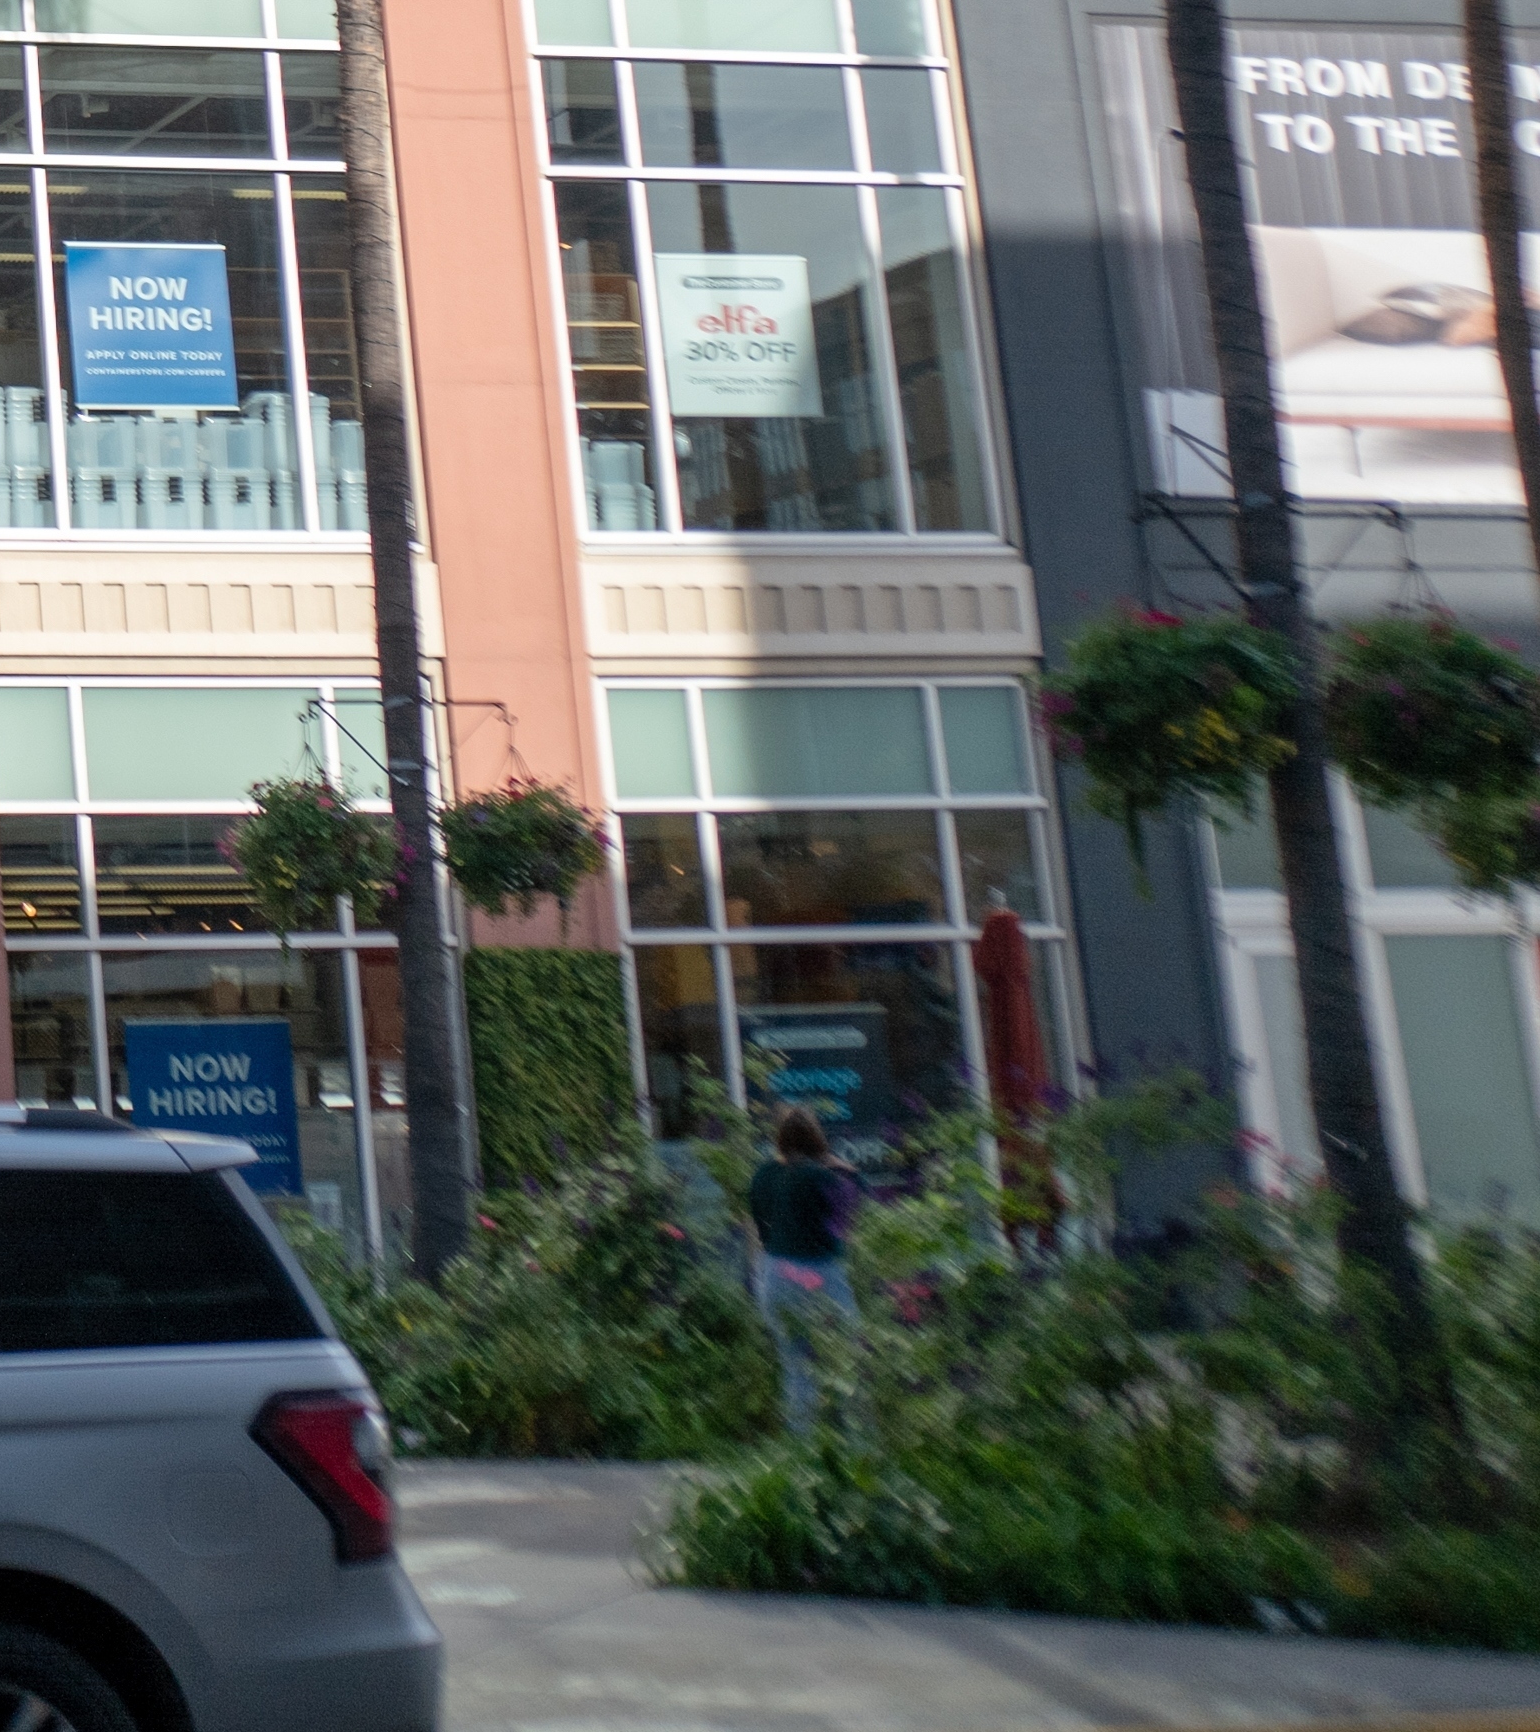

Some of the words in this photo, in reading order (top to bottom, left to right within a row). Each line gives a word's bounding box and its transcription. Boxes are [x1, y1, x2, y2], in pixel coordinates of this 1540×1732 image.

[1231, 56, 1393, 100] FROM
[1254, 113, 1335, 155] TO
[1344, 116, 1462, 158] THE
[108, 276, 188, 301] NOW
[88, 306, 213, 332] HIRING!
[696, 303, 779, 335] elfa
[85, 349, 125, 360] APPLY
[129, 349, 178, 361] ONLINE
[180, 350, 223, 361] TODAY
[684, 341, 740, 362] 30%
[746, 341, 797, 362] OFF
[169, 1053, 251, 1082] NOW
[148, 1085, 278, 1116] HIRING!
